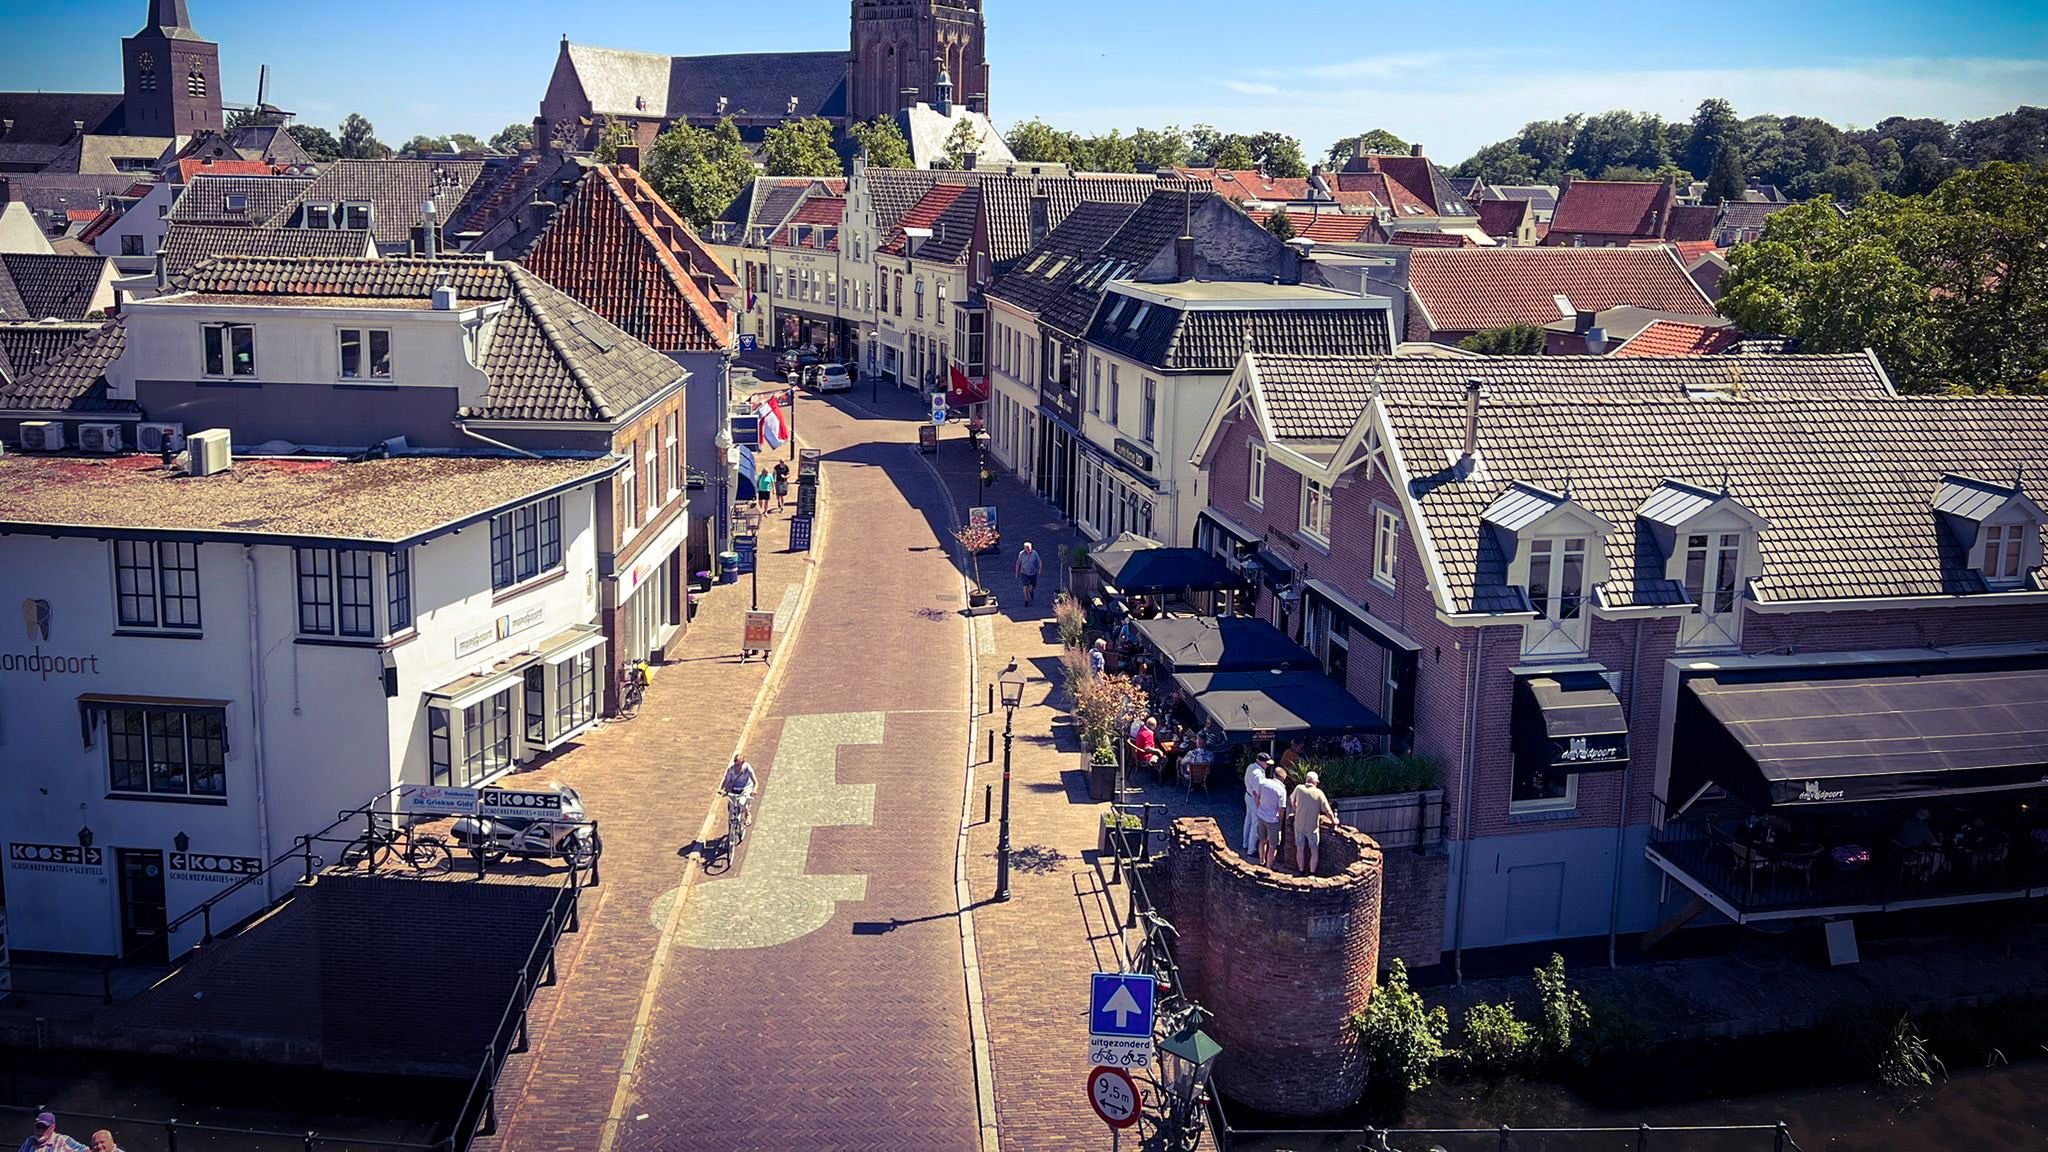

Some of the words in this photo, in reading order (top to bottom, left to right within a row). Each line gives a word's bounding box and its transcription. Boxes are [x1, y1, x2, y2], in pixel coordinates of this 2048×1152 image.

[0, 645, 99, 681] ondpoort
[426, 798, 454, 806] Griekse
[501, 794, 545, 807] KOOS
[12, 844, 63, 861] KOOS
[190, 855, 244, 872] KOOS
[1091, 1038, 1150, 1049] uitgezonderd
